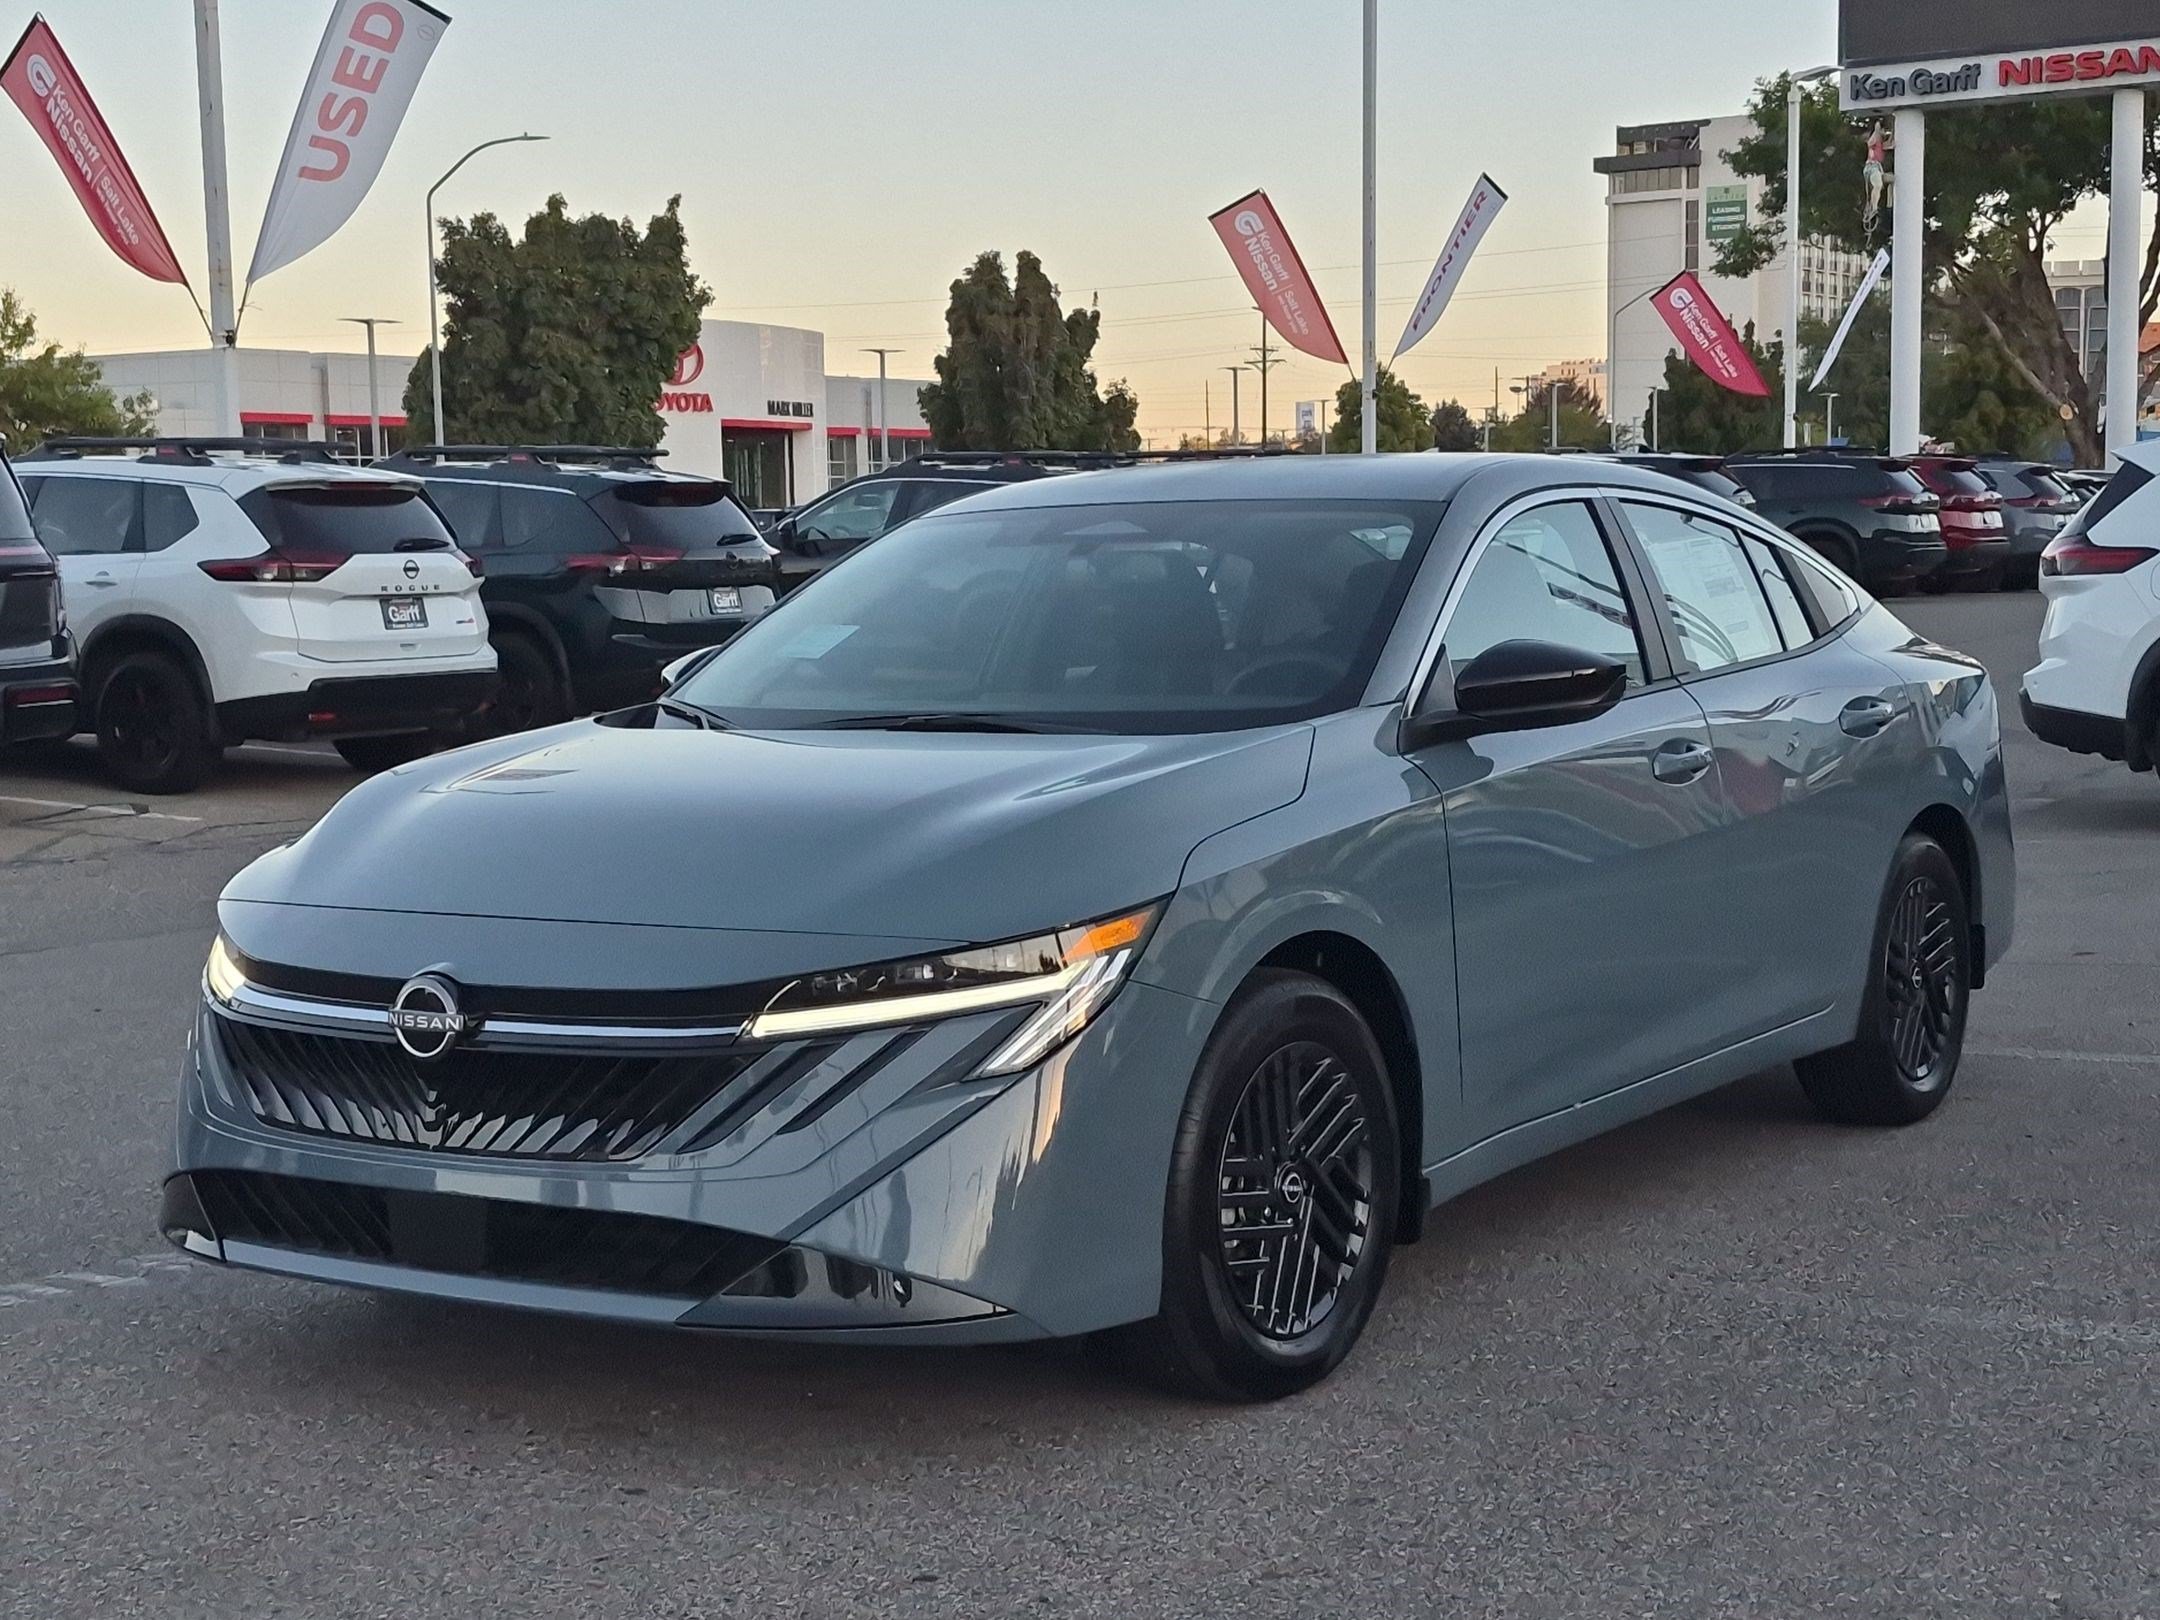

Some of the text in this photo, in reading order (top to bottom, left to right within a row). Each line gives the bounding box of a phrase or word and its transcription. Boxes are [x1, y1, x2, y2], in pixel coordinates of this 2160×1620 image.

[298, 2, 405, 182] USED
[1850, 73, 1905, 101] Ken
[1908, 63, 1982, 95] Garff
[46, 97, 93, 184] Nissan
[52, 84, 101, 163] Ken Garff
[100, 175, 122, 207] Salt
[116, 206, 140, 246] Lake
[1244, 236, 1279, 291] Nissan
[1257, 231, 1274, 255] Ken
[1269, 253, 1290, 281] Garff
[1412, 190, 1488, 332] FRONTIER
[1284, 290, 1298, 312] Salt
[1294, 310, 1309, 335] Lake
[1679, 307, 1709, 350] Nissan
[1687, 301, 1703, 320] Ken
[655, 392, 714, 412] OYOTA
[767, 400, 791, 416] MARK
[381, 584, 440, 592] ROGUE
[713, 592, 738, 608] Garff
[388, 604, 420, 622] Garff
[389, 1012, 460, 1031] NISSAN
